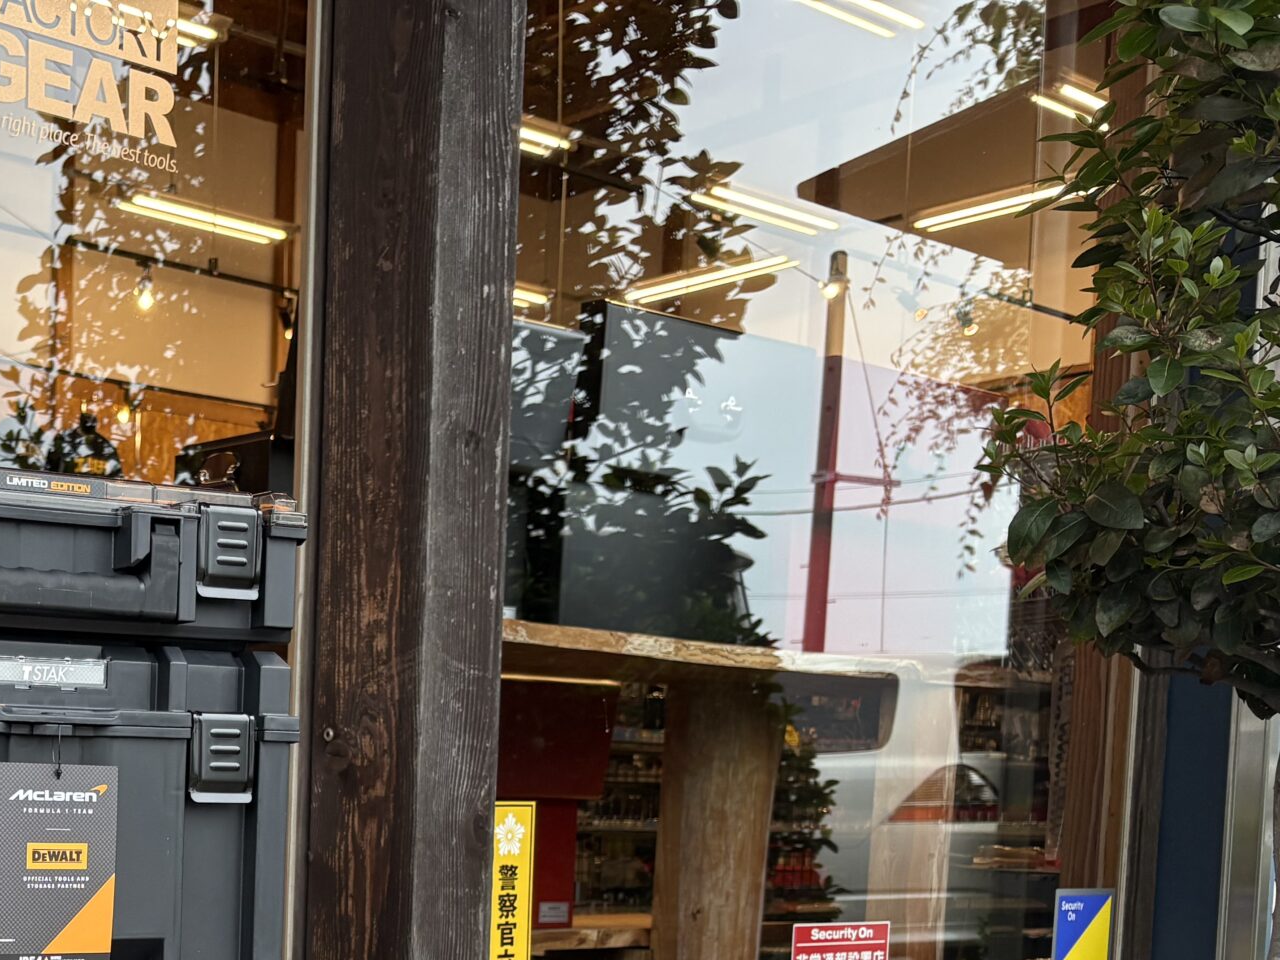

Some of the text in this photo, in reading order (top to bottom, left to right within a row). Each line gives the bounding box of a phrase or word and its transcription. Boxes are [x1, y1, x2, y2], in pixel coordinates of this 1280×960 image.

[1, 112, 37, 137] right
[143, 150, 178, 174] tools.
[6, 476, 91, 493] LIMITED EDITION
[9, 789, 97, 802] McLaren
[1061, 901, 1084, 912] Security
[1067, 912, 1076, 921] On
[811, 927, 874, 941] Security On
